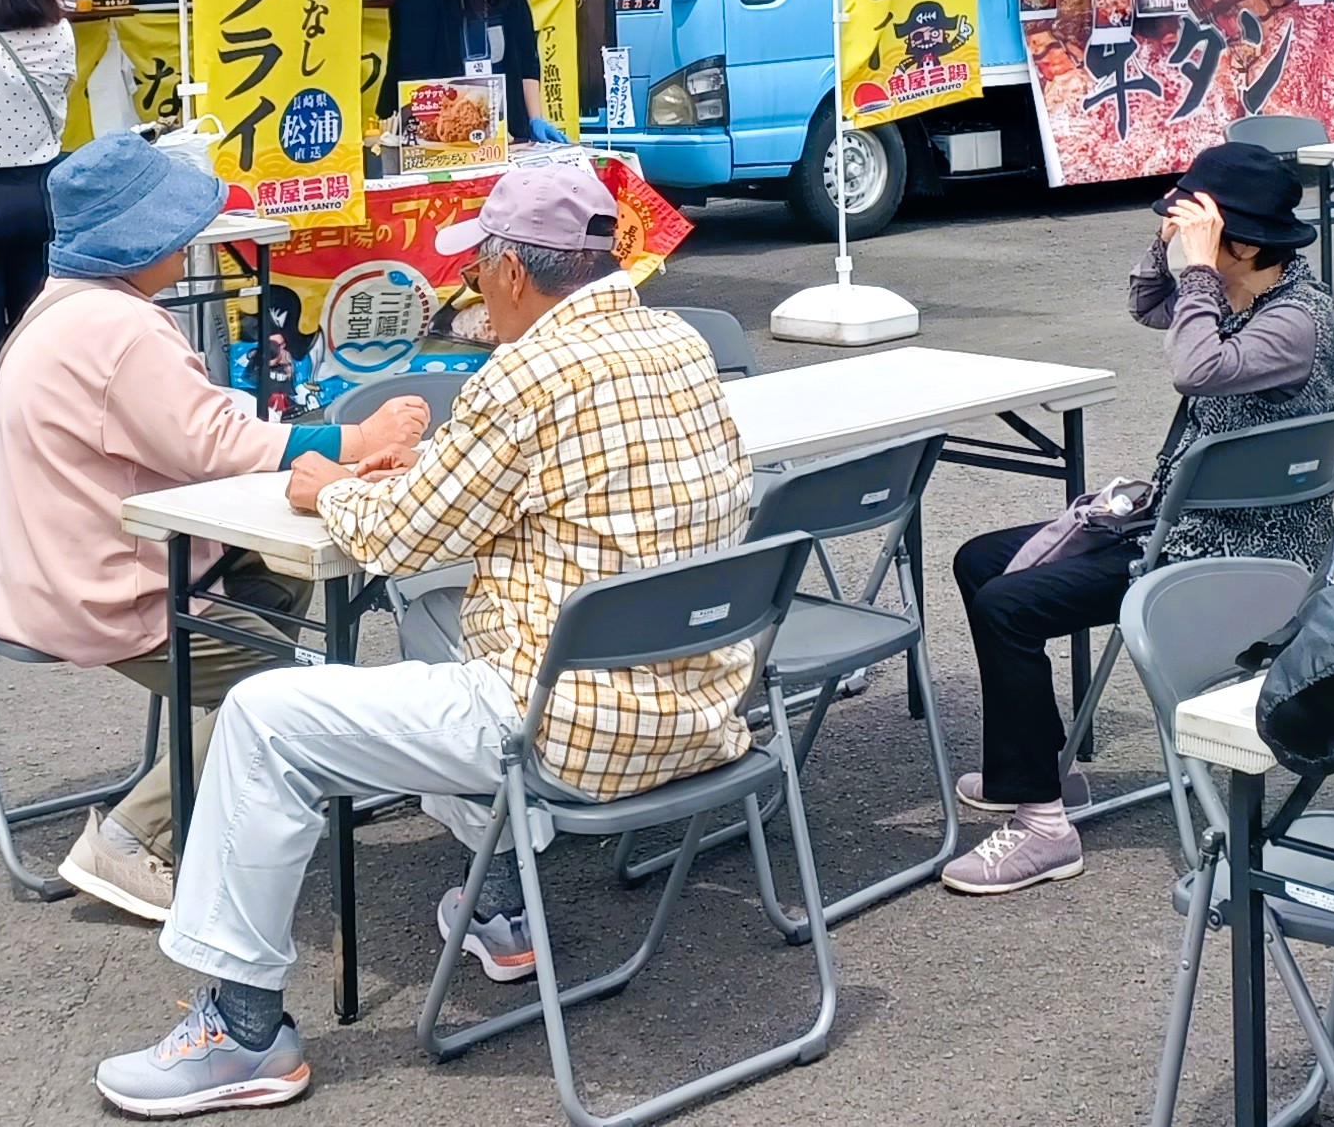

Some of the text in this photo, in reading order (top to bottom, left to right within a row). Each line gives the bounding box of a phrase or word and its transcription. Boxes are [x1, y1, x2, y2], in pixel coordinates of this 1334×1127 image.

[888, 63, 968, 97] 魚屋三陽
[898, 82, 962, 103] SAKANAYA SANYO
[292, 94, 328, 111] 長崎県
[281, 110, 340, 148] 松浦
[294, 145, 323, 161] 直送
[257, 174, 350, 207] 魚屋三陽
[265, 200, 342, 215] SAKANAYA SANYO
[347, 292, 375, 340] 食堂
[375, 292, 402, 338] 三陽
